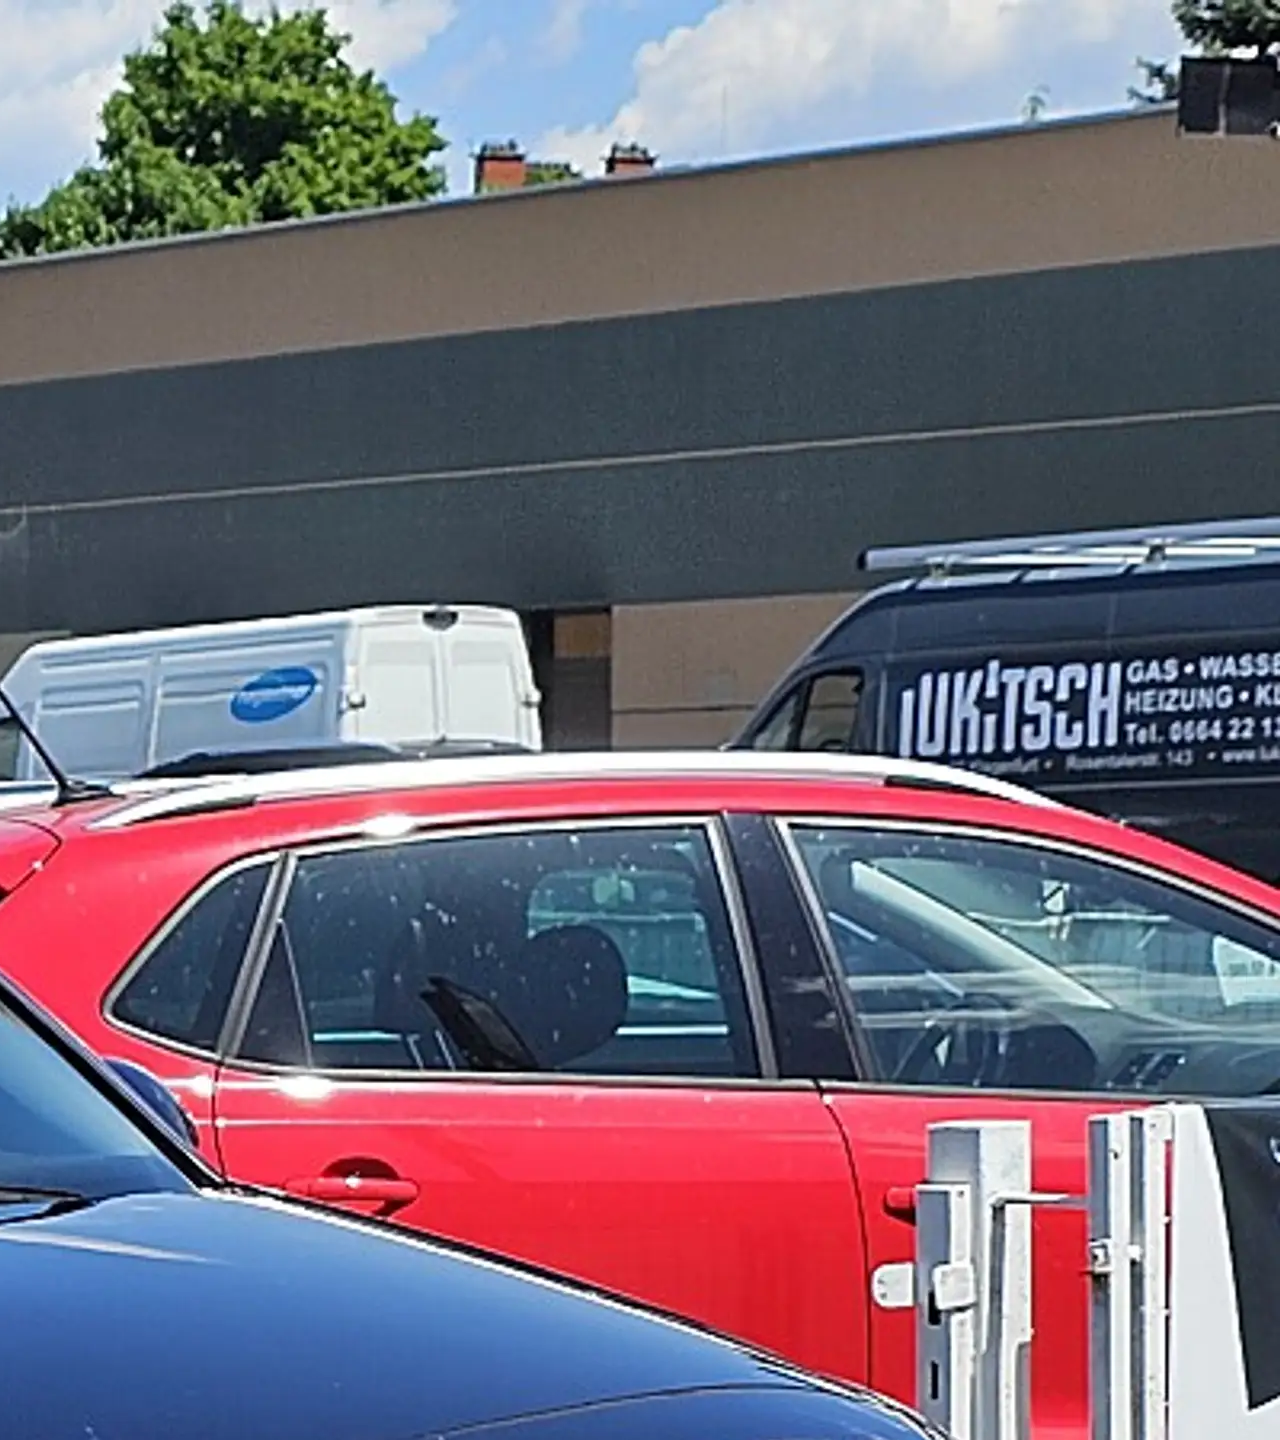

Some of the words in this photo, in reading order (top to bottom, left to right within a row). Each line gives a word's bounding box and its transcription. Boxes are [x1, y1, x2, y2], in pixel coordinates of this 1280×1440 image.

[1126, 658, 1179, 684] GAS
[1124, 685, 1234, 715] HEIZUNG
[1227, 716, 1255, 740] 22
